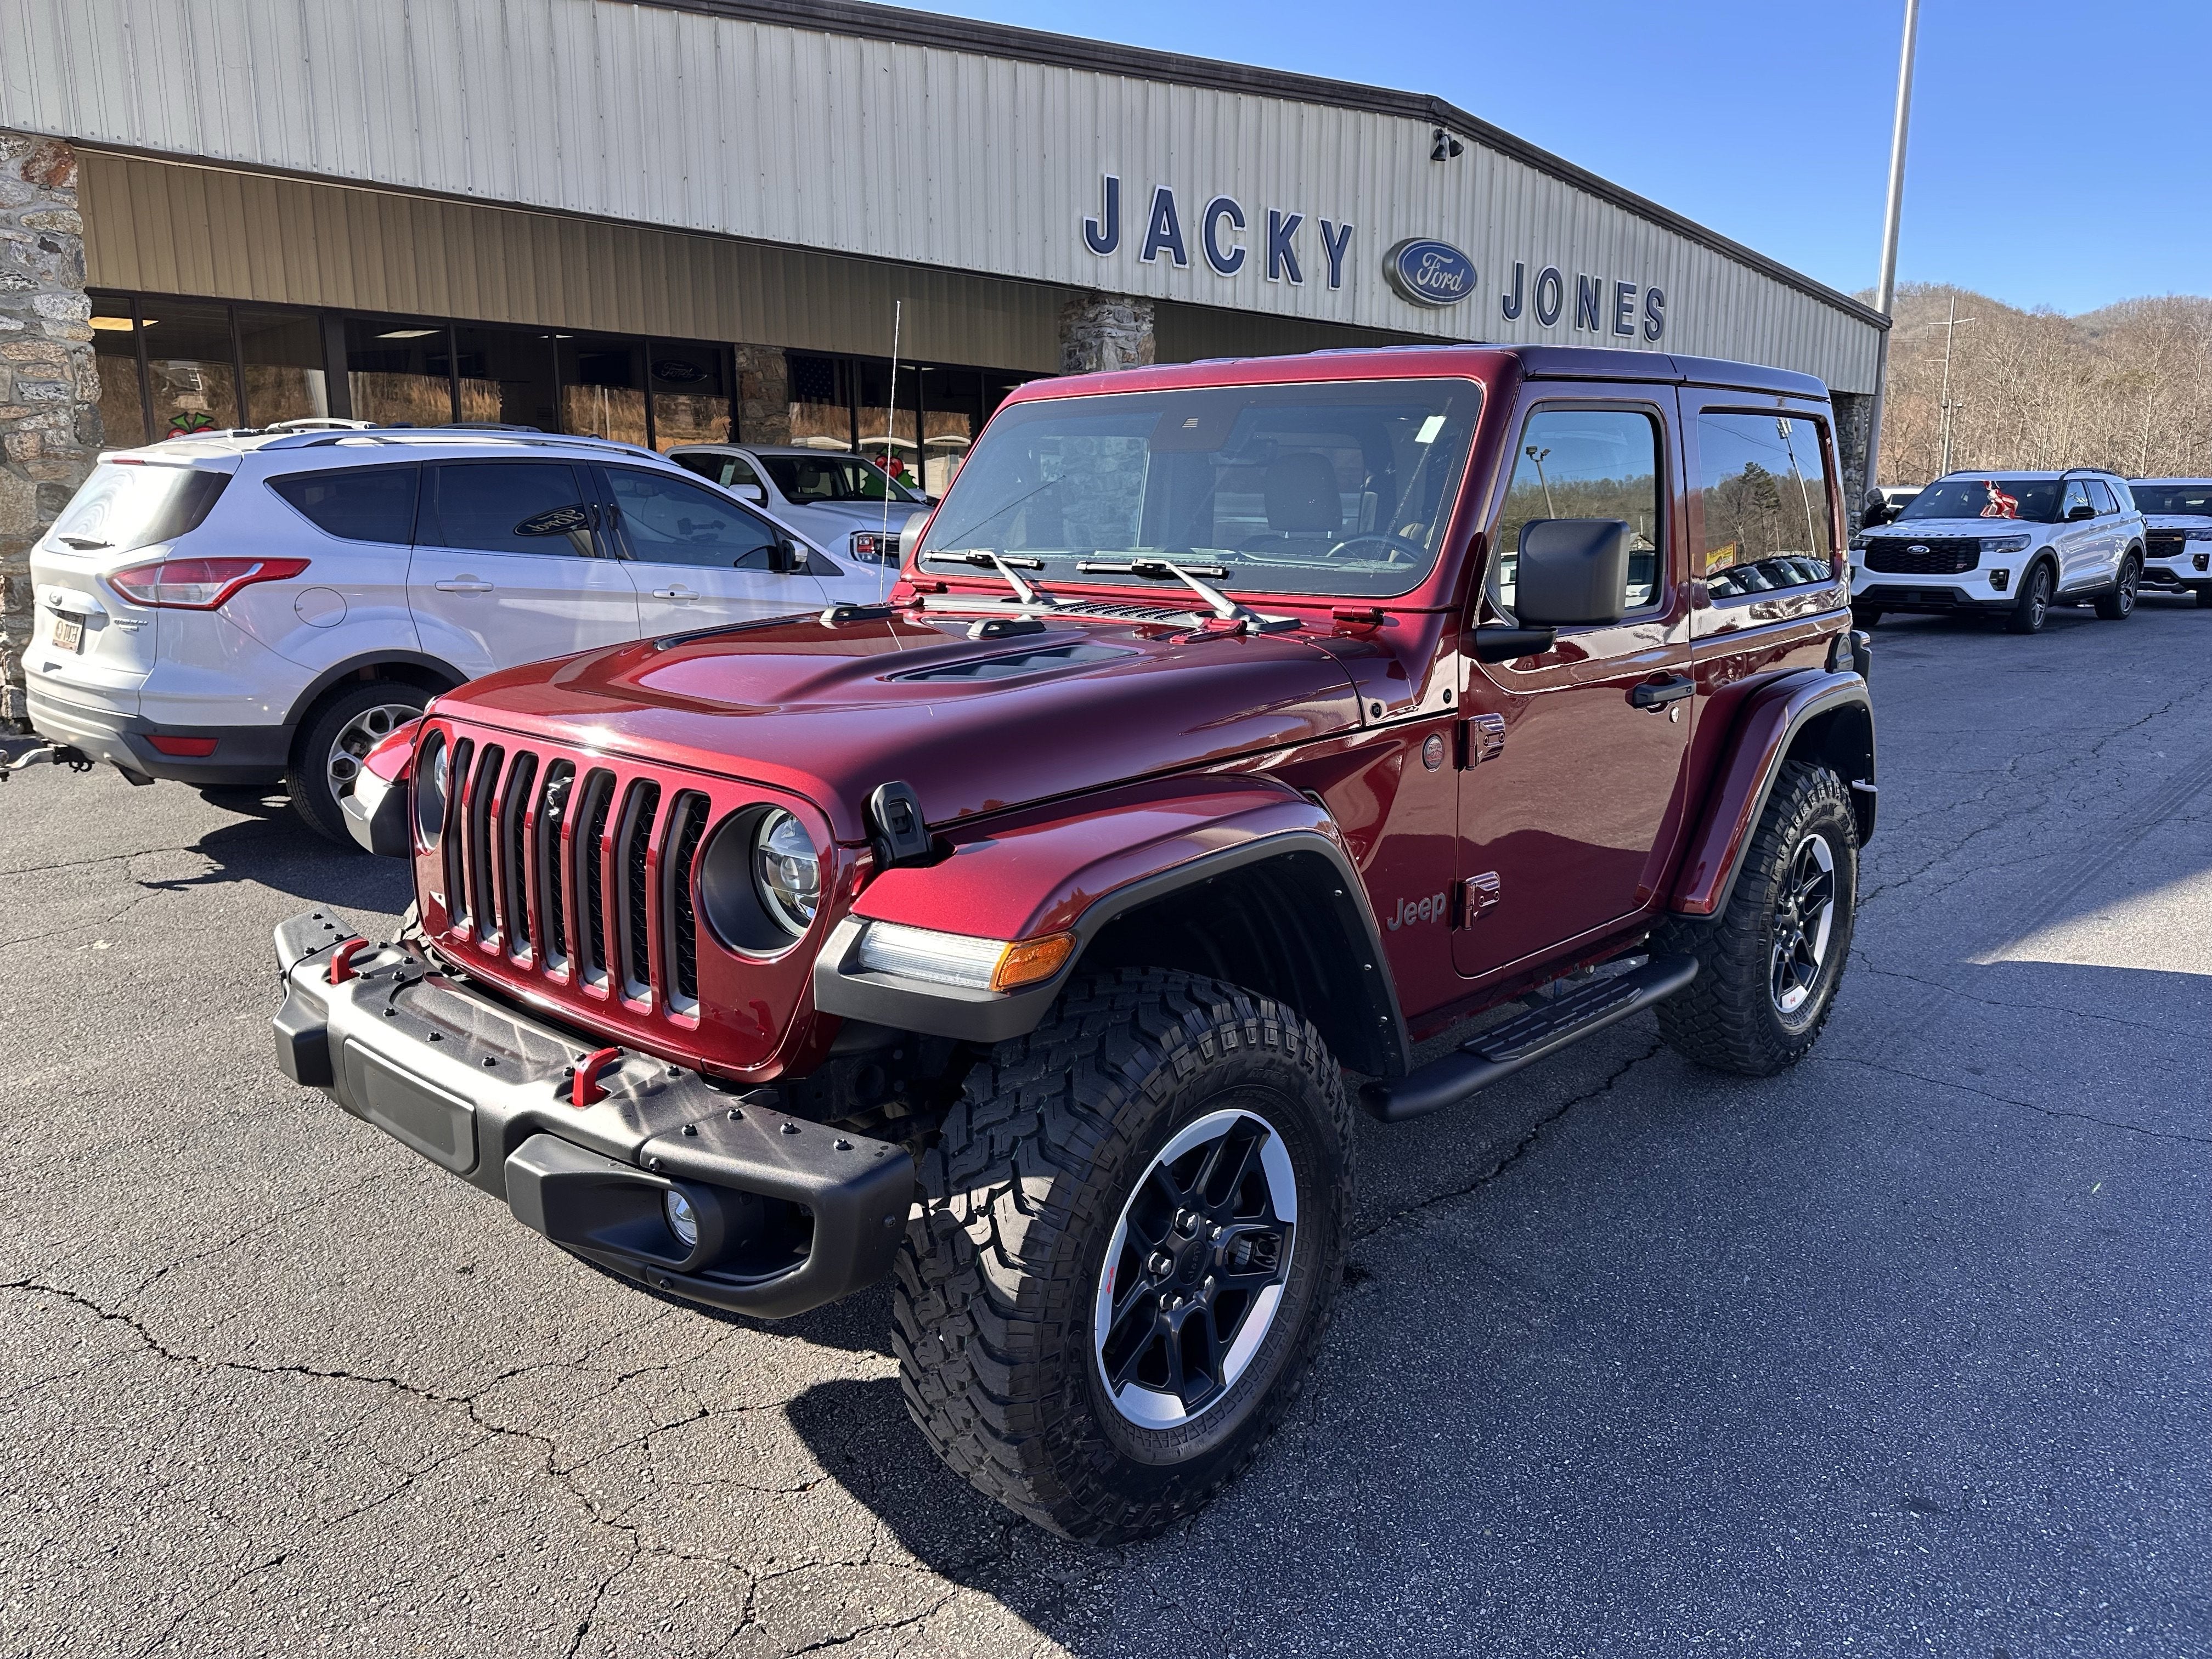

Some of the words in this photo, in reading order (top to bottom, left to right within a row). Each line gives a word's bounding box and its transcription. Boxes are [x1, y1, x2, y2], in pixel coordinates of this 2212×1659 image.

[1083, 173, 1354, 291] JACKY
[1501, 260, 1665, 342] JONES
[1417, 252, 1465, 292] Ford
[1386, 892, 1446, 931] Jeep
